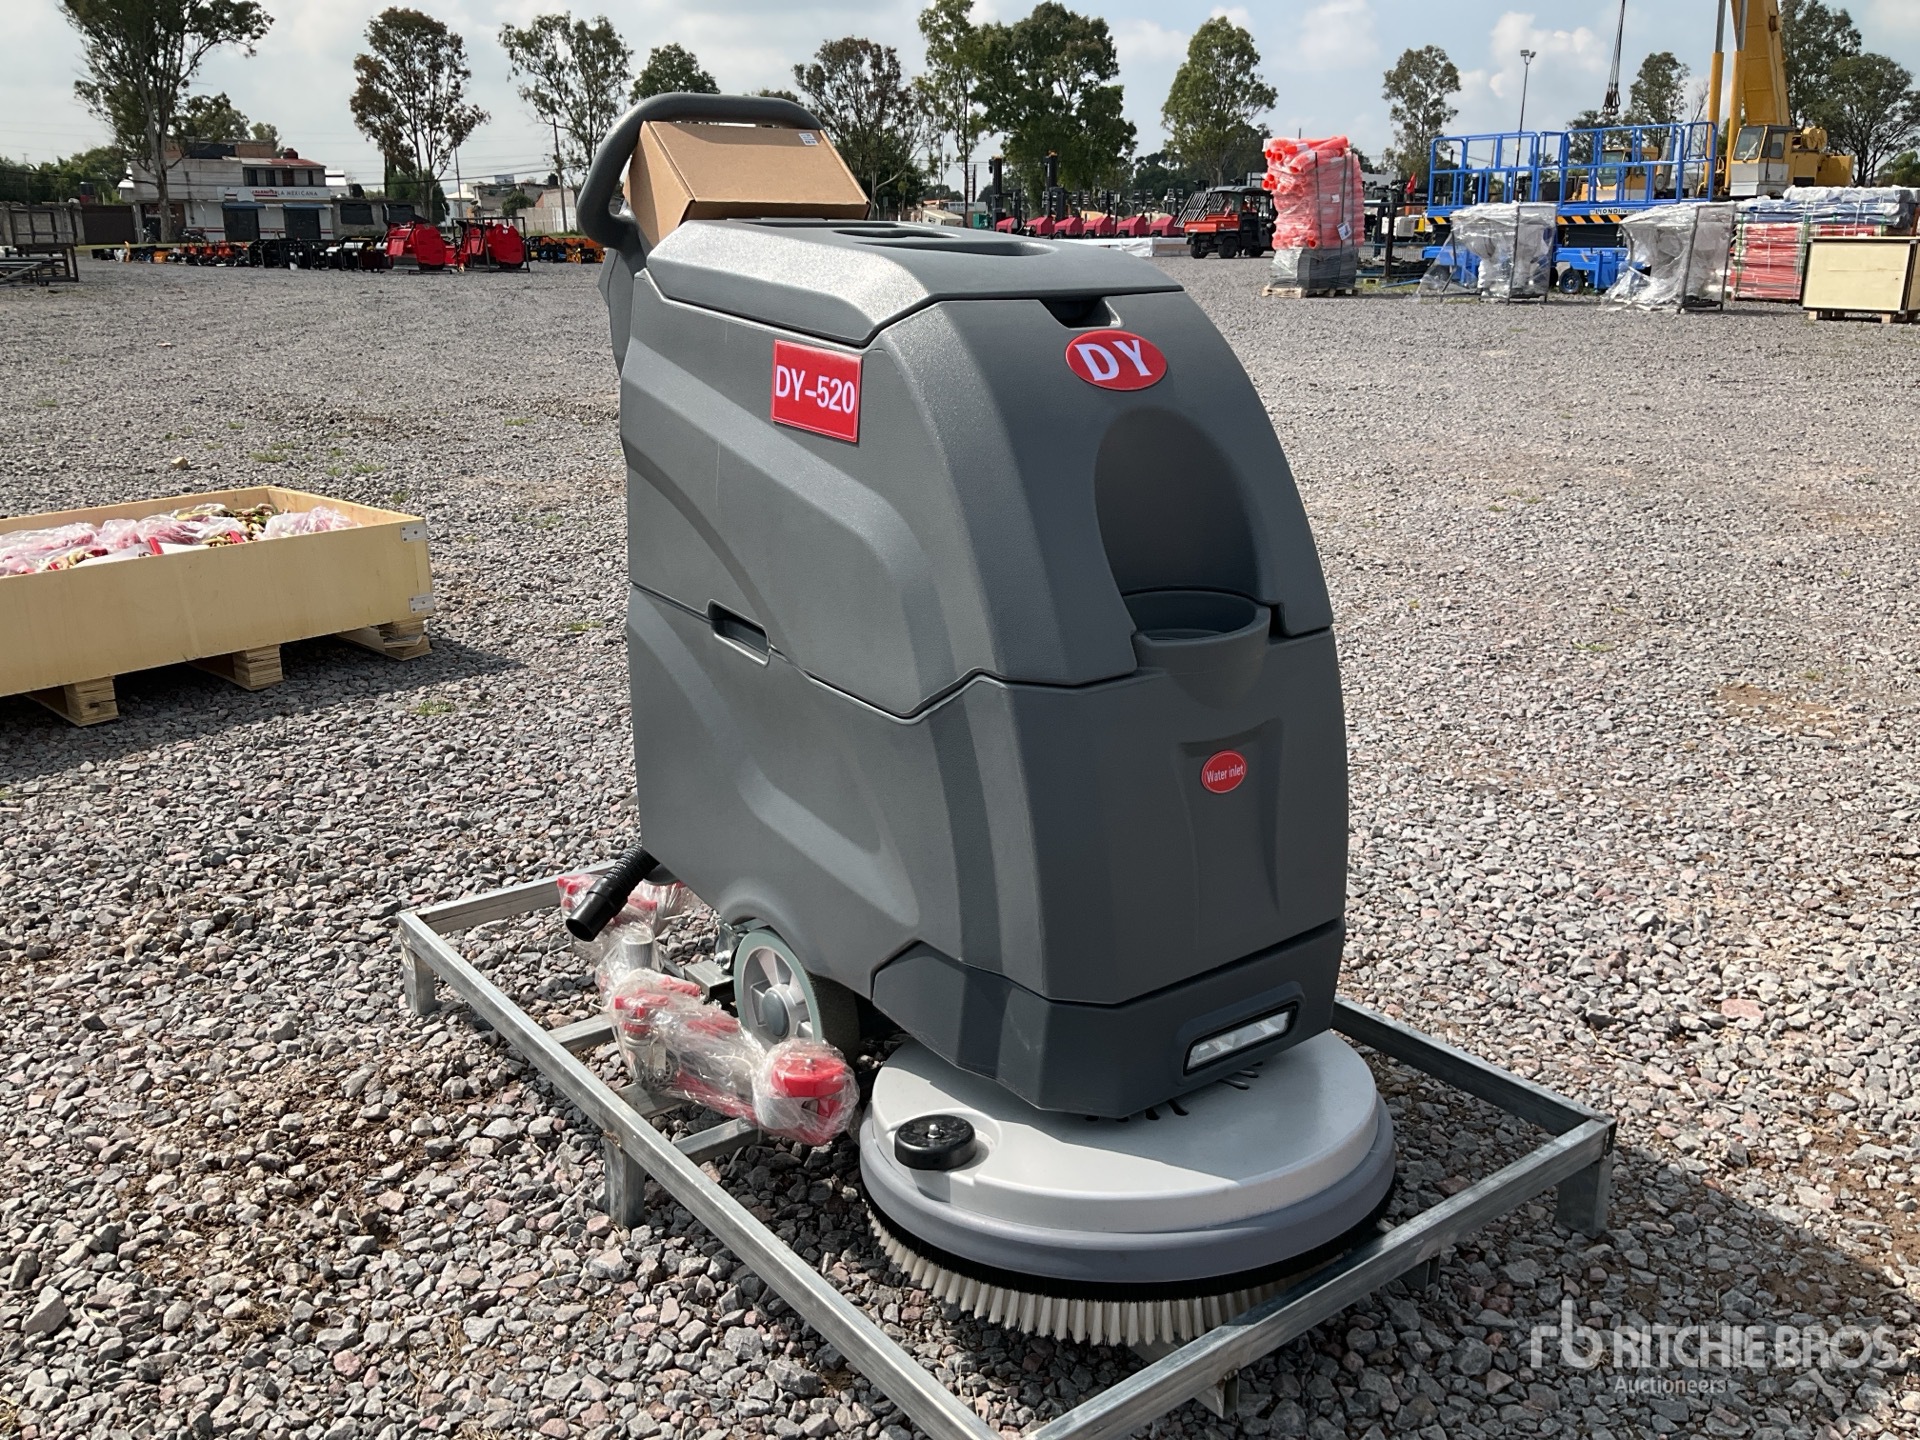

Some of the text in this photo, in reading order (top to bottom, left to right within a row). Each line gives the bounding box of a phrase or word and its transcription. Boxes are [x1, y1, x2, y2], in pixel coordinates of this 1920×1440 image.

[1073, 340, 1152, 381] DY
[775, 365, 855, 414] DY-520
[1206, 764, 1244, 783] Water inlet
